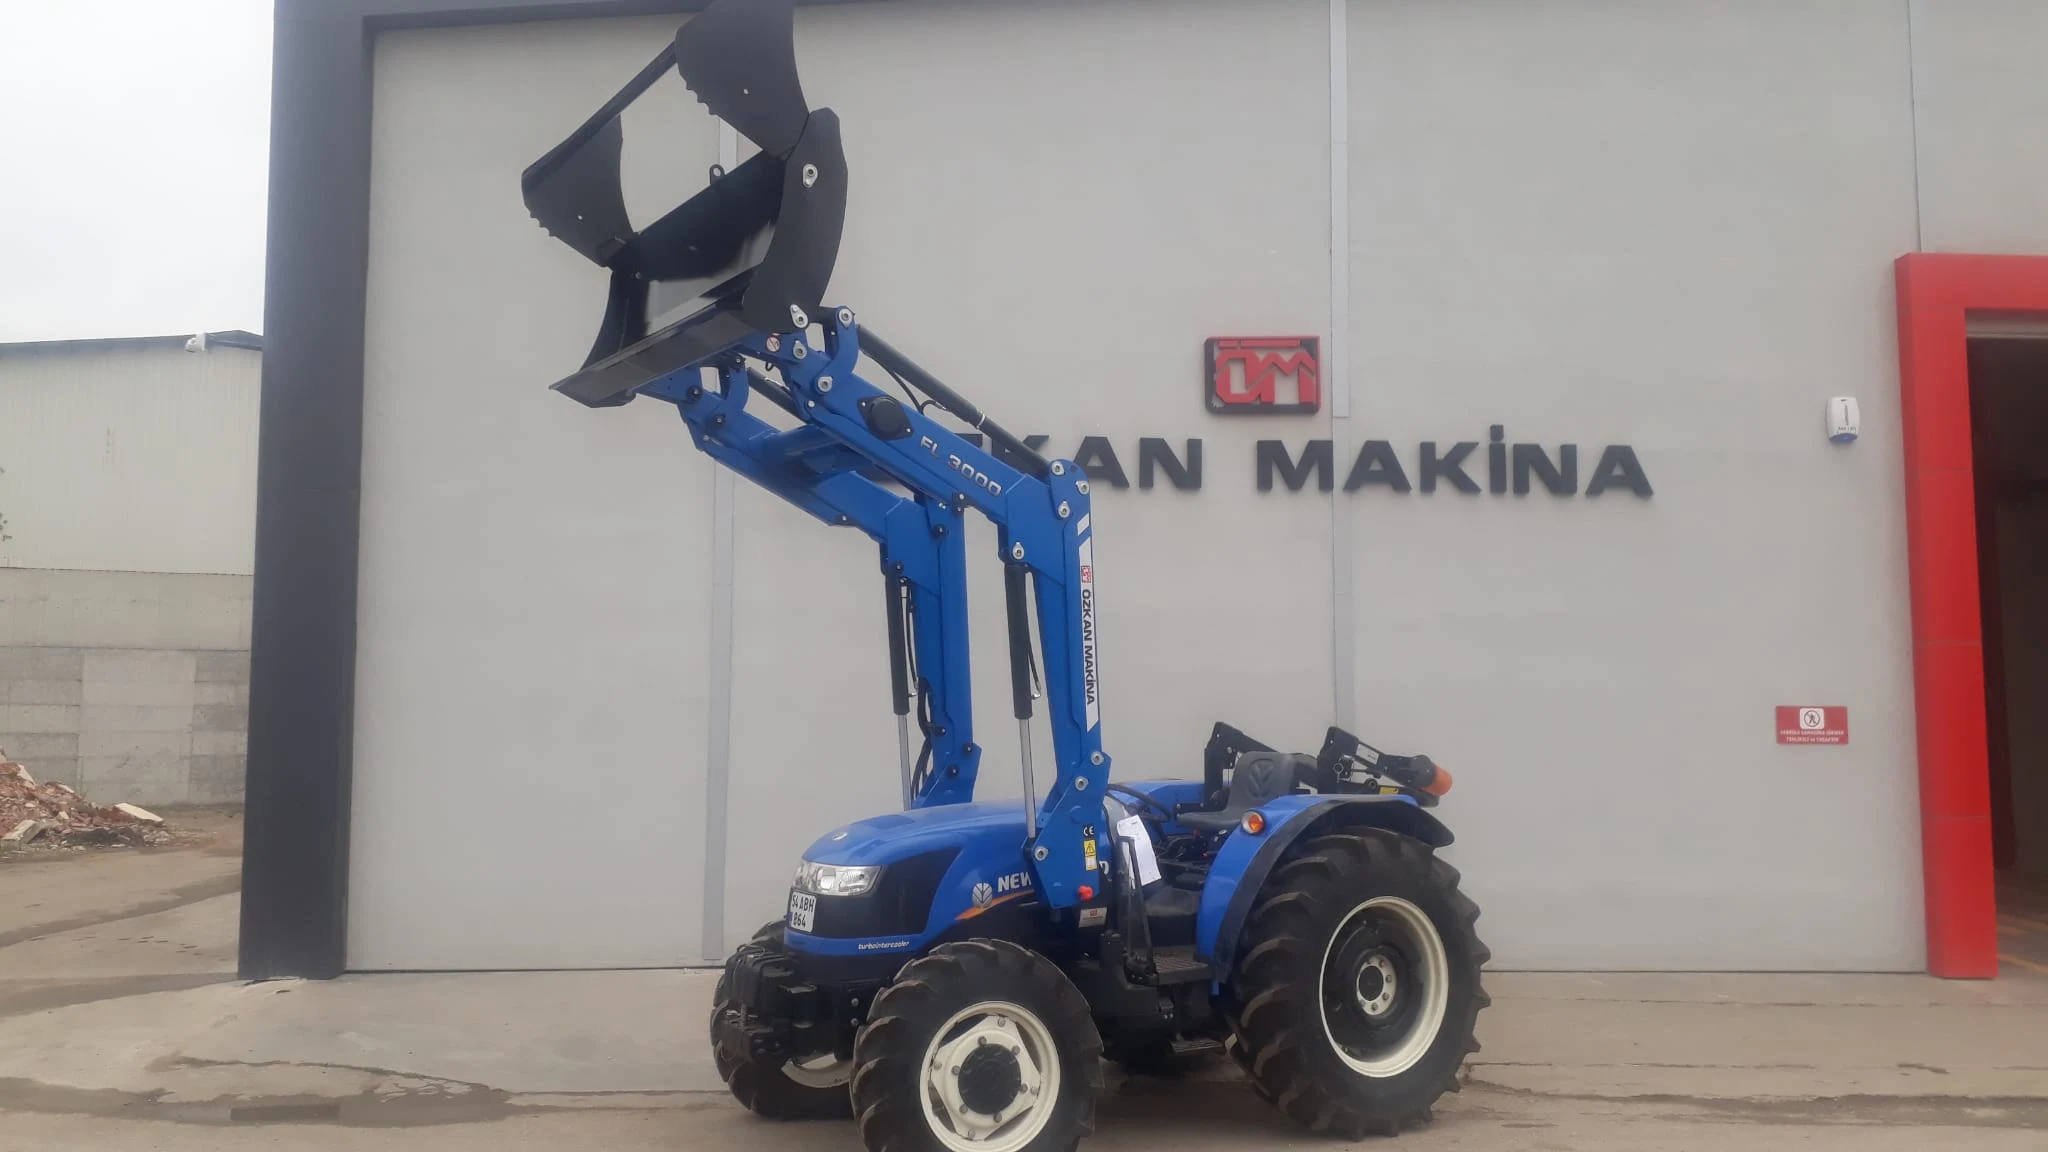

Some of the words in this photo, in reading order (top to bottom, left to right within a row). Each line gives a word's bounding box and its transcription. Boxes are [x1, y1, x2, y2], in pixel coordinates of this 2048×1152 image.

[920, 435, 940, 459] FL
[947, 453, 1003, 497] 3000
[1256, 424, 1654, 499] MAKİNA
[1081, 588, 1093, 642] ÖZKAN
[1084, 644, 1096, 706] MAKİNA
[998, 871, 1032, 893] NEW
